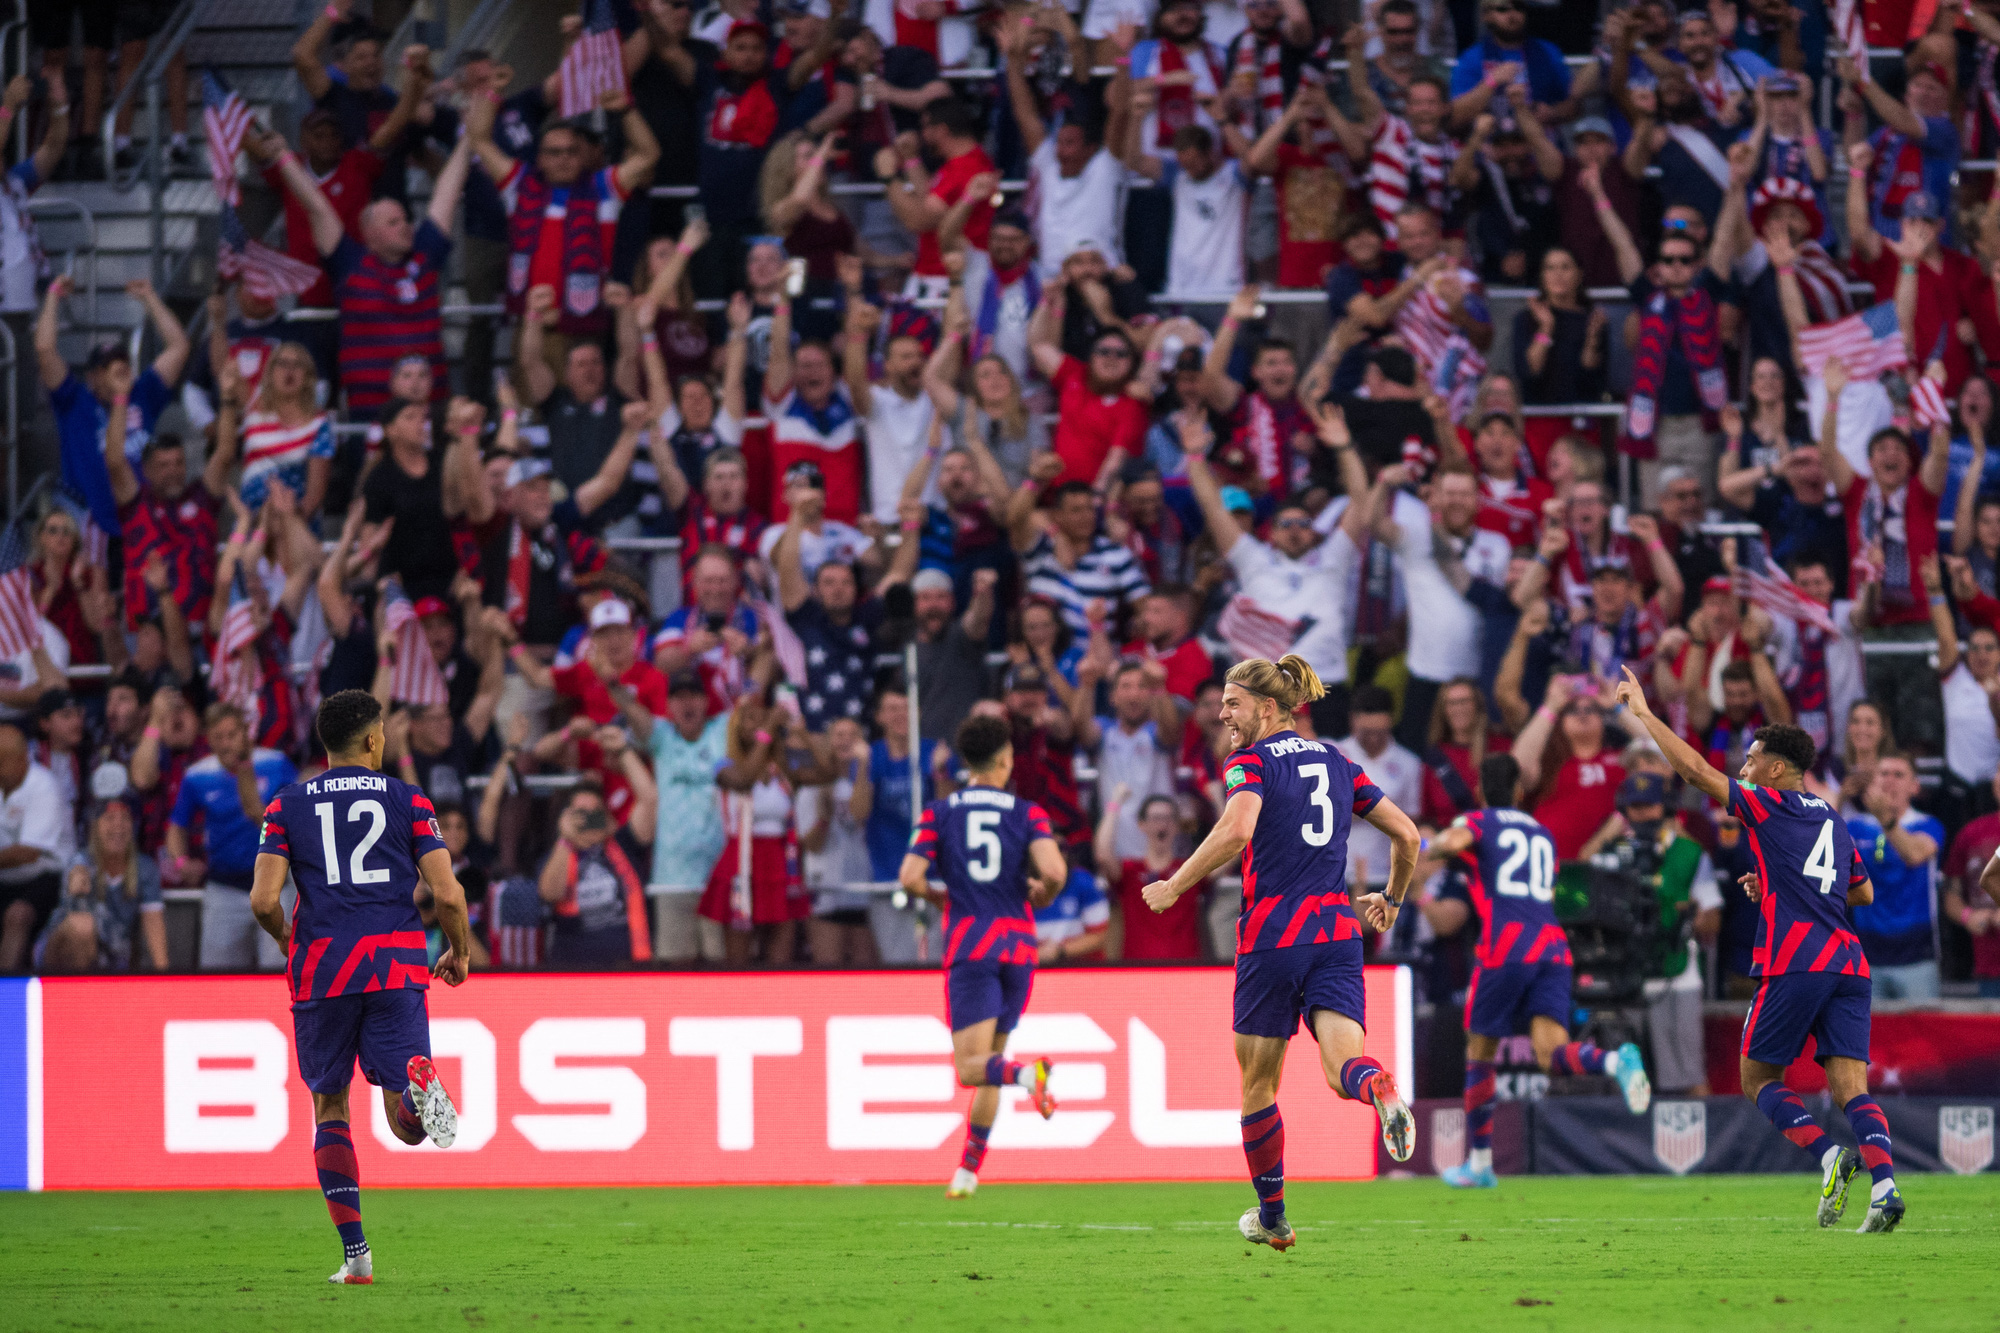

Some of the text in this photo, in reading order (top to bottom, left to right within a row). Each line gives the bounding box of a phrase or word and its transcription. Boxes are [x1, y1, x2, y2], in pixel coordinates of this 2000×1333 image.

[306, 776, 387, 795] M. ROBINSON
[1297, 763, 1334, 847] 3
[314, 799, 391, 885] 12
[966, 810, 1002, 883] 5
[1496, 827, 1555, 904] 20
[1802, 818, 1837, 894] 4
[163, 1014, 1243, 1154] BOSTEEL
[1944, 1109, 1989, 1138] USA
